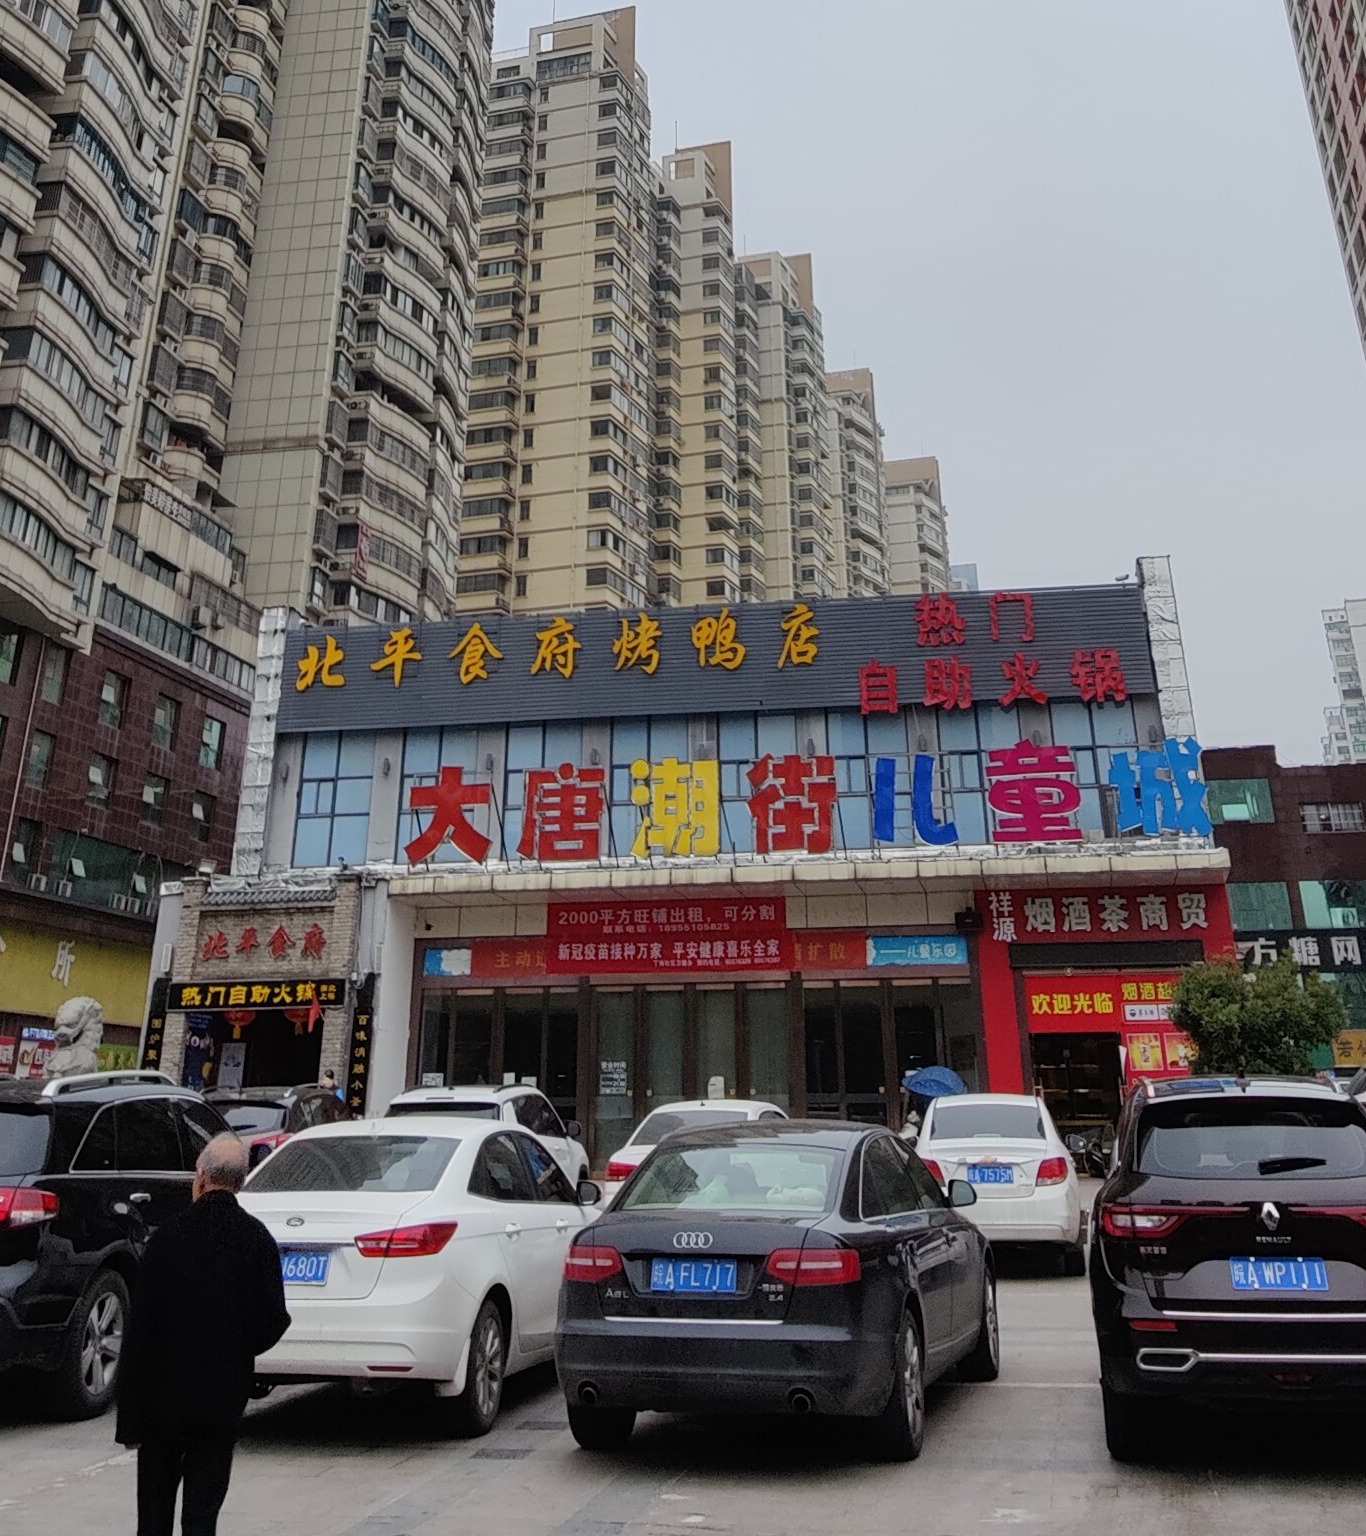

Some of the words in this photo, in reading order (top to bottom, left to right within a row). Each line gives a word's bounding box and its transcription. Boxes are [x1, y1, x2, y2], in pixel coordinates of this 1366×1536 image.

[914, 591, 1034, 648] 热门
[296, 603, 821, 691] 北平食府烤鸭店
[859, 648, 1128, 716] 自助火锅
[404, 734, 1214, 868] 大唐潮街儿童城
[987, 891, 1018, 943] 祥源
[1024, 892, 1210, 933] 烟酒茶商贸
[558, 941, 663, 962] 新冠疫苗接种万家
[673, 938, 780, 959] 平安健康喜乐全家
[181, 983, 315, 1007] 热门自助火锅
[1031, 992, 1114, 1015] 欢迎光临
